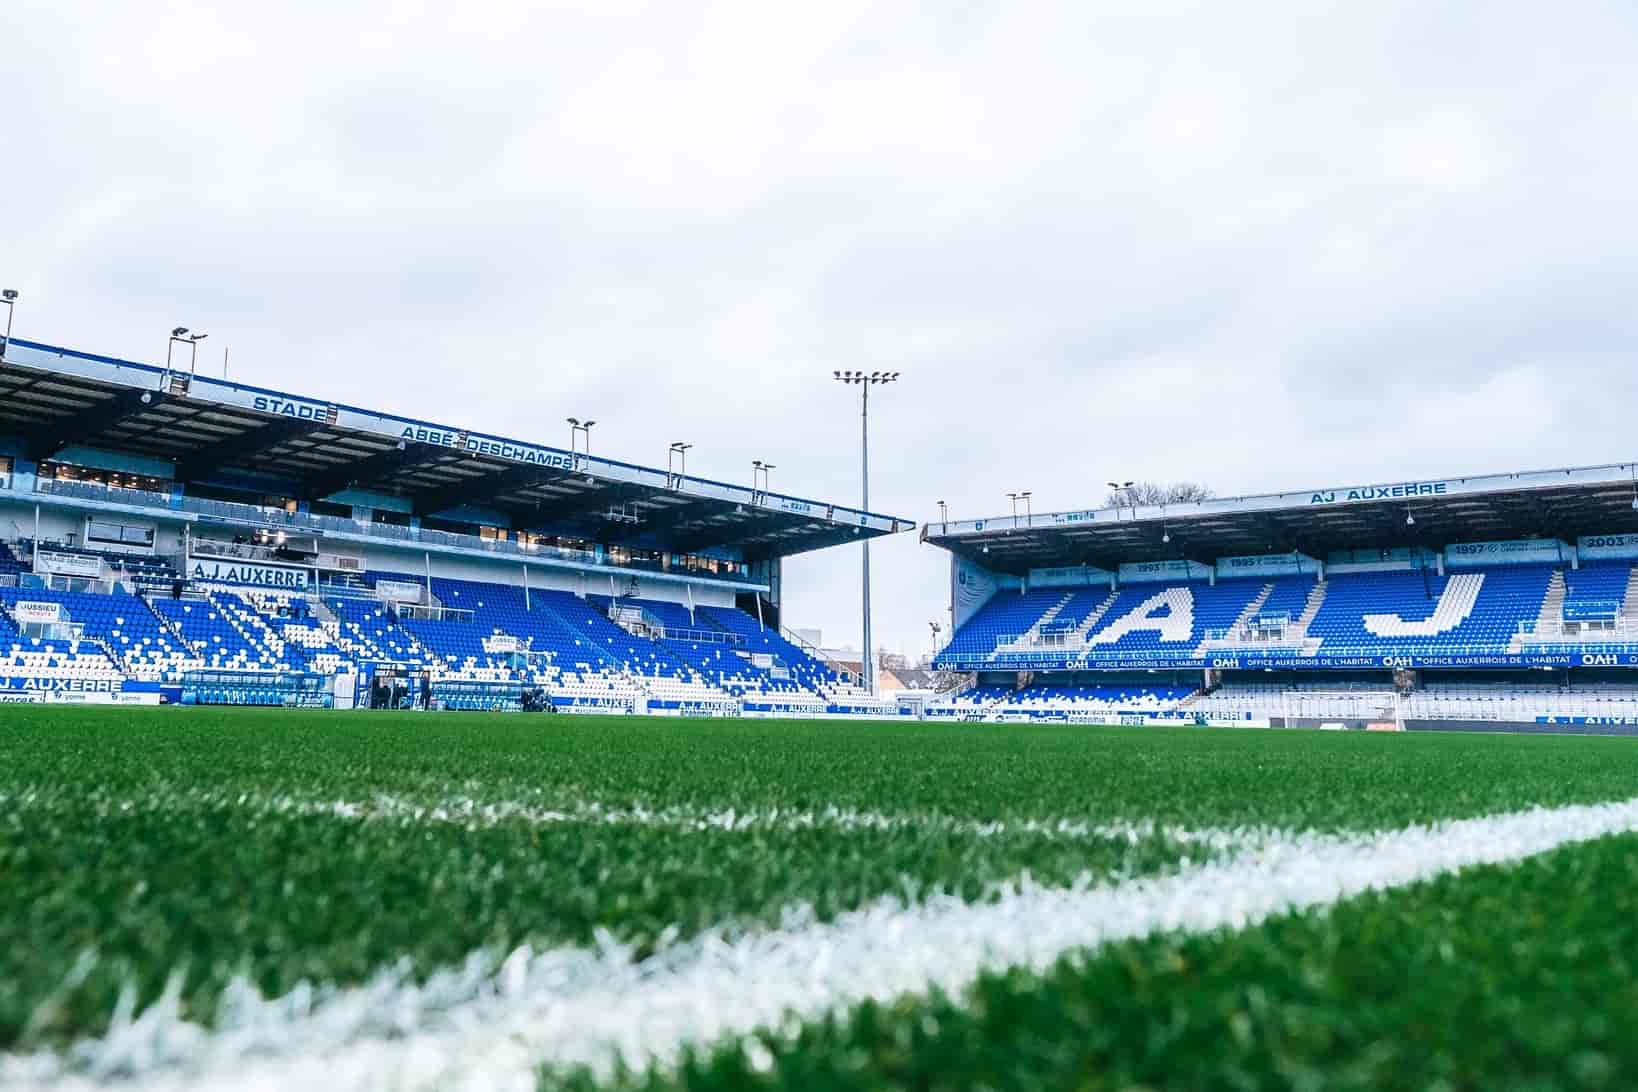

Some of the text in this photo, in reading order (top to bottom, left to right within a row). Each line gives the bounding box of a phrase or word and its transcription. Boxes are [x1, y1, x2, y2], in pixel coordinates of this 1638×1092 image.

[253, 397, 326, 422] STADE
[467, 438, 573, 469] DESCHAMPS
[1311, 483, 1447, 504] AJ AUXERRE
[23, 678, 121, 692] AUXERRE
